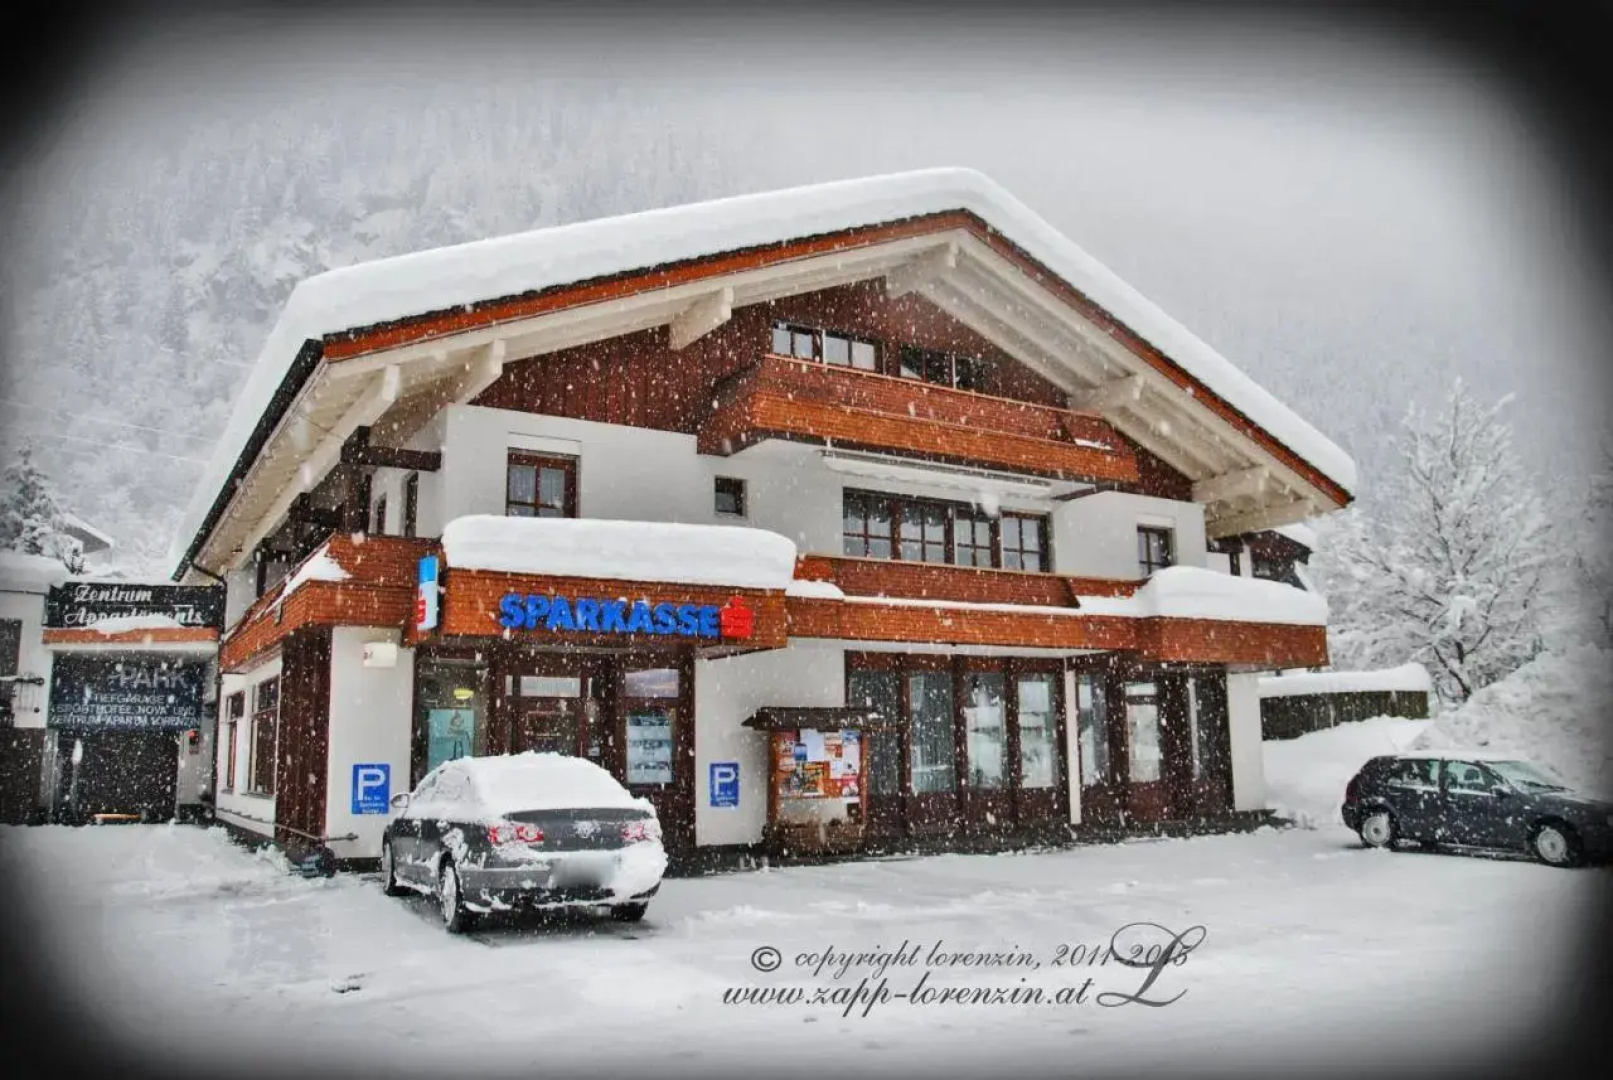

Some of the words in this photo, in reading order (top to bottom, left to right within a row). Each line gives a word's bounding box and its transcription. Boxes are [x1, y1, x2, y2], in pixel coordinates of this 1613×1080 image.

[74, 585, 153, 603] Zentrum
[500, 593, 721, 639] SPARKASSE
[358, 769, 386, 801] P
[714, 767, 737, 796] P
